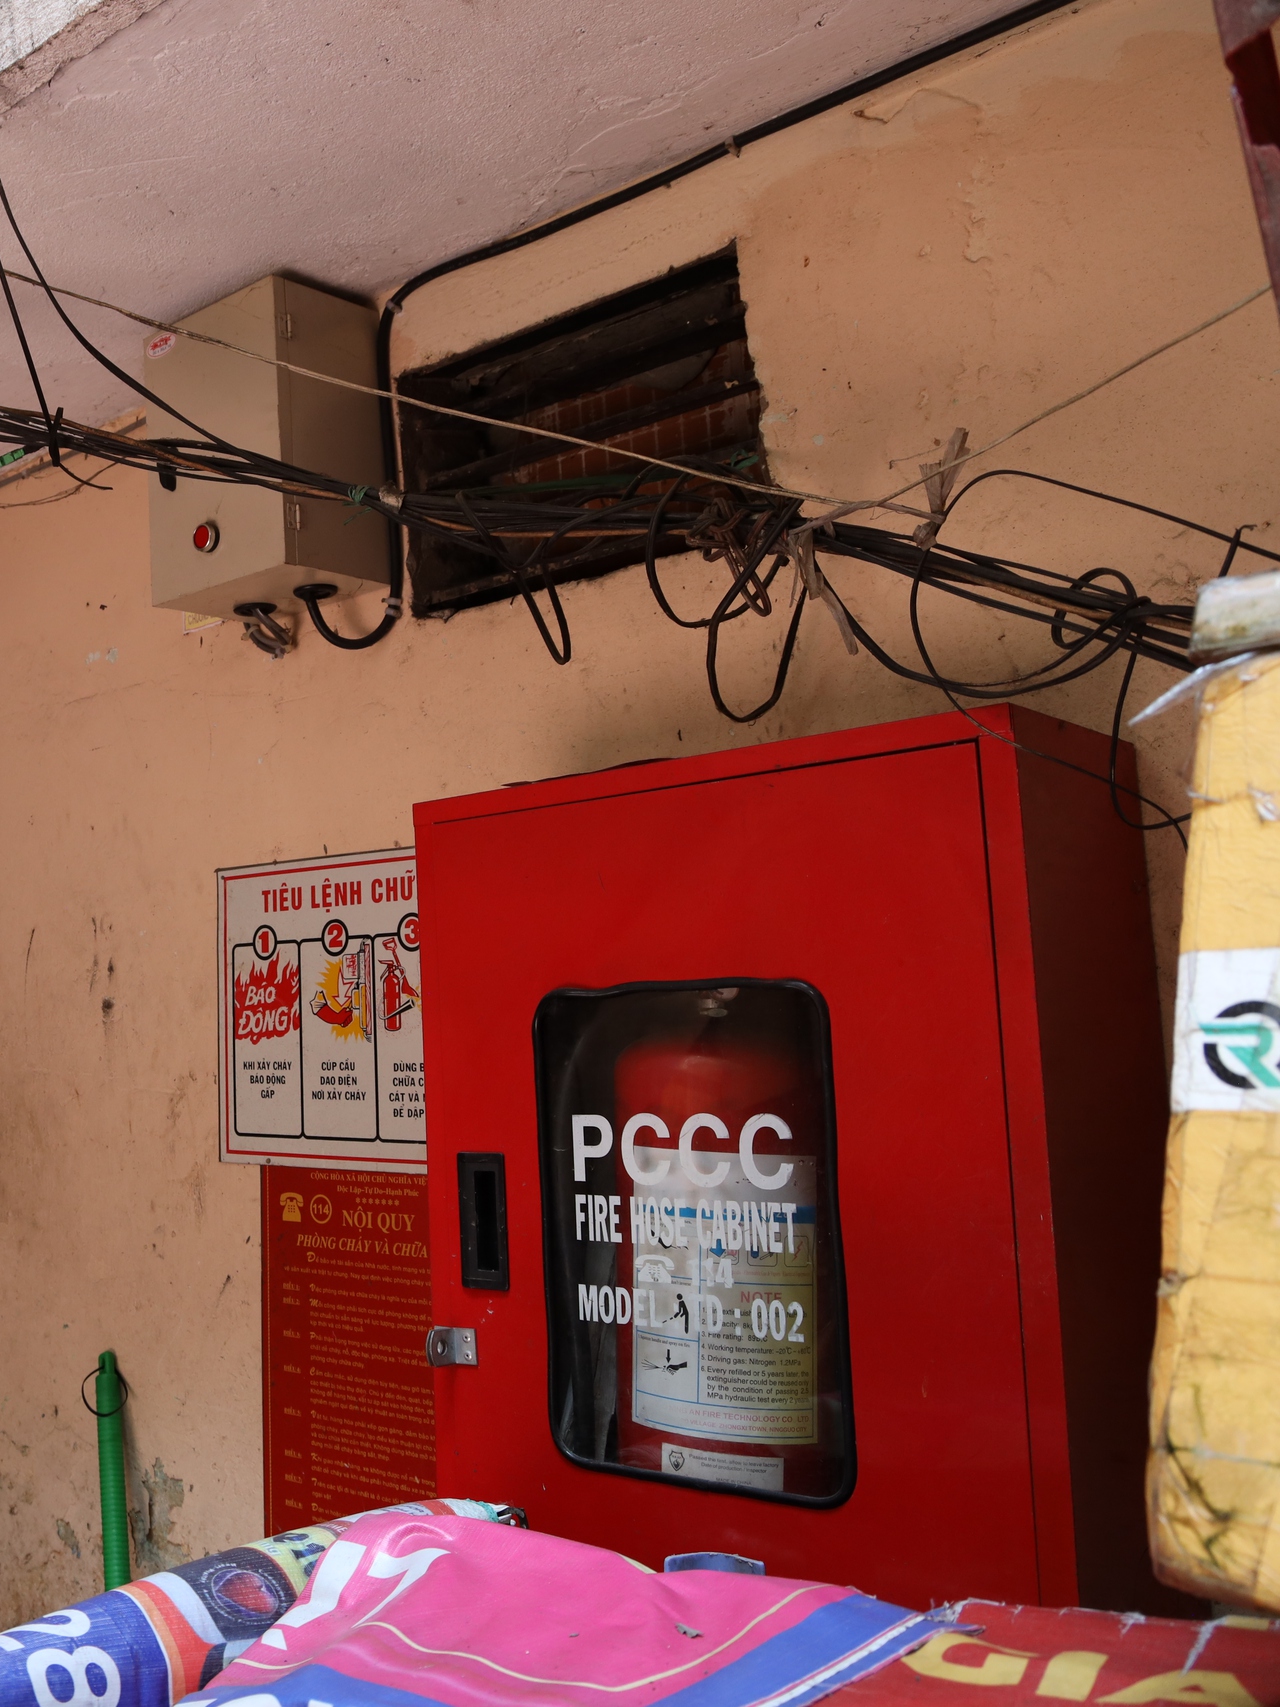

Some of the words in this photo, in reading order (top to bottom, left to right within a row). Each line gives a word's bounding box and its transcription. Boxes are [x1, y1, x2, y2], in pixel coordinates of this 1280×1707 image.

[262, 883, 302, 912] TIÊU
[311, 878, 361, 912] LỆNH
[371, 869, 415, 903] CHỮ
[328, 924, 343, 948] 2
[404, 919, 419, 945] 3
[258, 931, 269, 953] 1
[245, 982, 276, 1006] BÁO
[243, 1061, 255, 1070] KHI
[257, 1058, 270, 1070] XẢY
[273, 1059, 291, 1070] CHÁY
[321, 1060, 337, 1071] CÚP
[339, 1058, 355, 1071] CẦU
[394, 1061, 417, 1072] DÙNG
[250, 1073, 264, 1084] BÁO
[267, 1073, 285, 1085] ĐỘNG
[320, 1076, 335, 1085] DAO
[338, 1074, 357, 1087] ĐIỆN
[393, 1075, 415, 1086] CHỮA
[261, 1086, 275, 1099] GẤP
[327, 1088, 342, 1100] XẢY
[345, 1089, 366, 1101] CHÁY
[389, 1091, 405, 1102] CÁT
[409, 1091, 419, 1102] VÀ
[393, 1104, 404, 1117] ĐỂ
[408, 1106, 424, 1120] DẬP
[571, 1112, 794, 1190] PCCC
[313, 1204, 329, 1215] 114
[342, 1206, 373, 1232] NỘI
[377, 1212, 415, 1233] QUY
[575, 1194, 622, 1243] FIRE
[630, 1196, 689, 1247] HOSE
[696, 1199, 797, 1254] CABINET
[297, 1232, 336, 1249] PHÒNG
[339, 1236, 371, 1252] CHÁY
[375, 1238, 389, 1255] VÀ
[393, 1241, 428, 1258] CHỮA
[578, 1283, 663, 1328] MODEL
[751, 1298, 805, 1342] 002
[708, 1343, 734, 1353] Working
[707, 1355, 731, 1365] Driving
[749, 1359, 776, 1367] Nitrogen
[707, 1367, 726, 1375] Every
[732, 1386, 763, 1394] condition
[707, 1392, 723, 1400] MPa
[725, 1393, 756, 1402] hydraulic
[703, 1410, 720, 1418] FIRE
[723, 1413, 780, 1423] TECHNOLOGY
